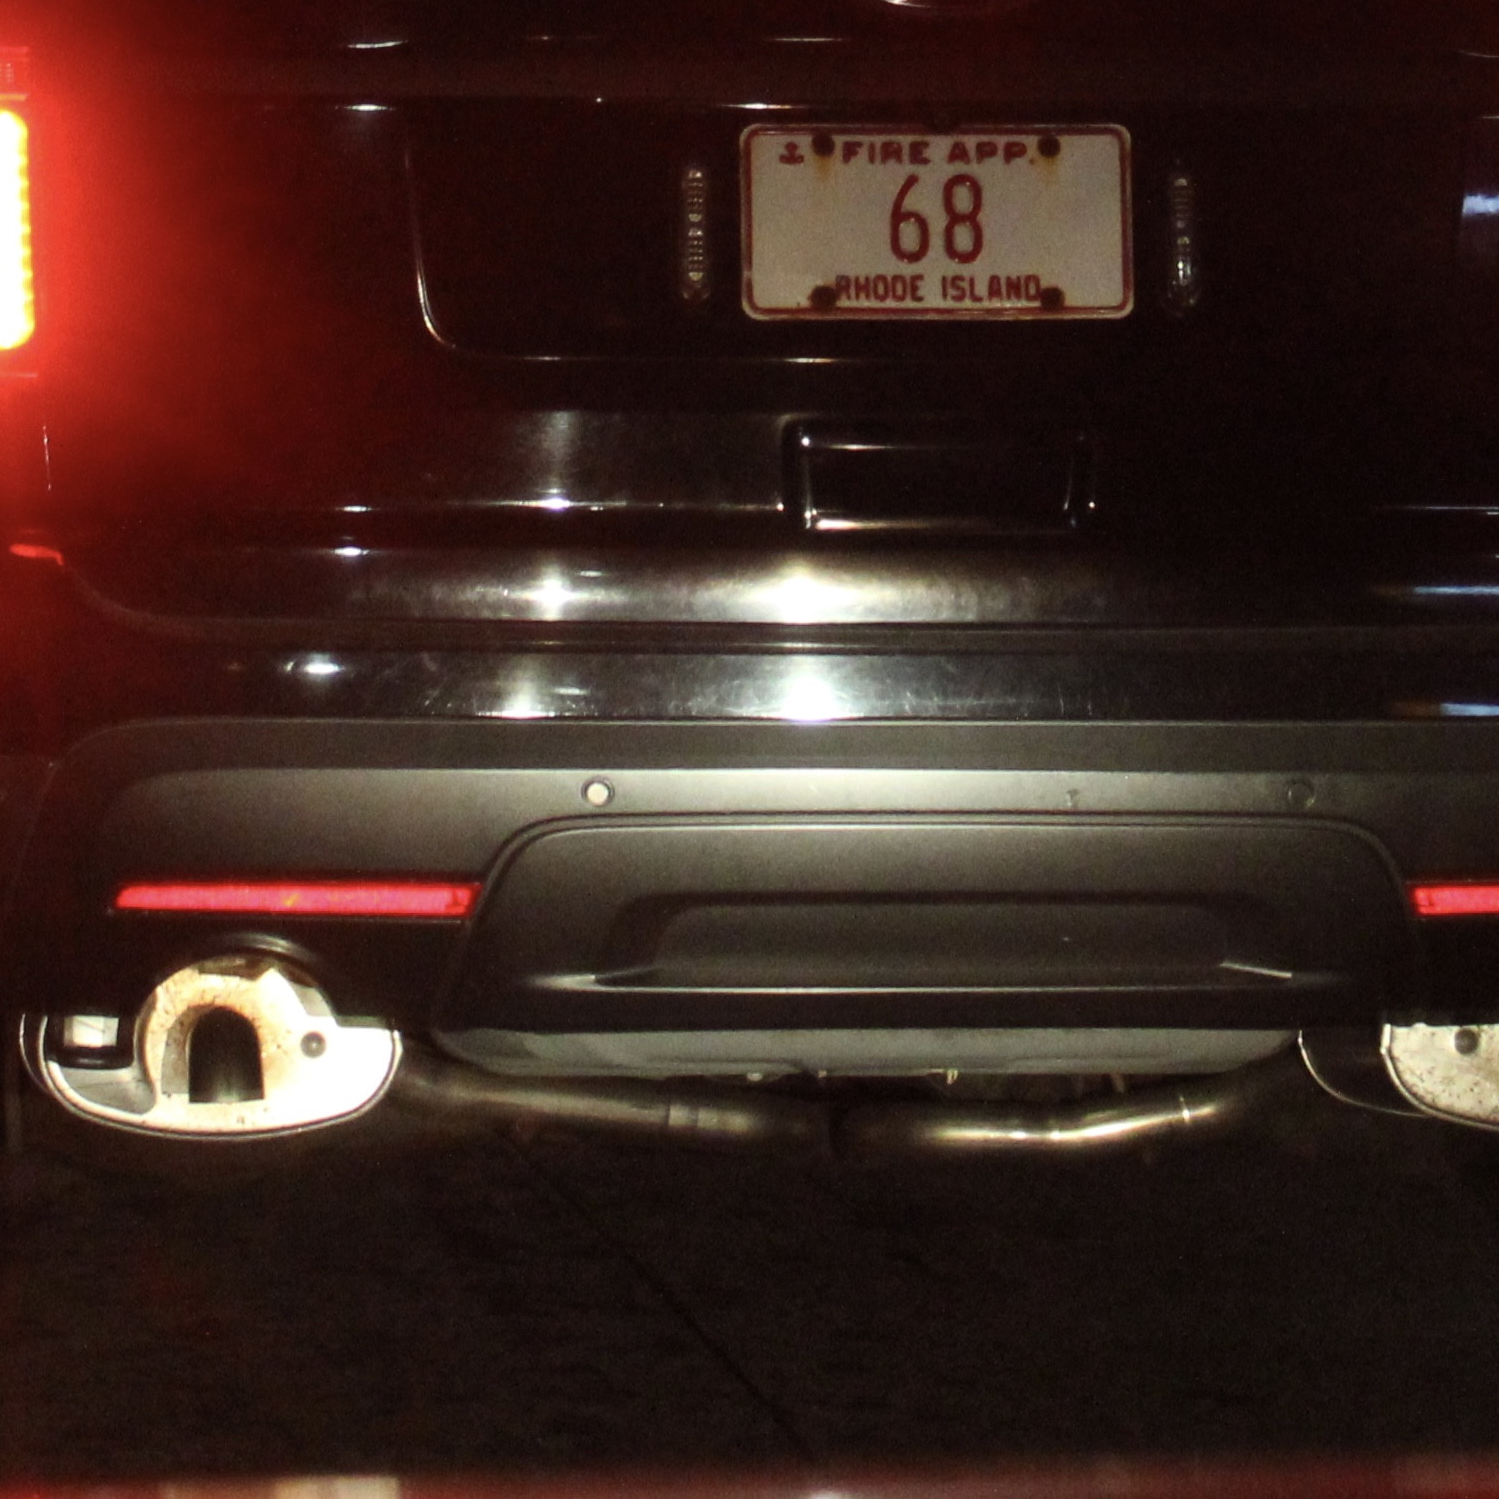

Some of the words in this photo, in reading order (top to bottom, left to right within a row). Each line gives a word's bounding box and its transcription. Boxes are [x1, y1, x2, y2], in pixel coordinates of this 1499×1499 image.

[842, 141, 931, 165] FIRE
[947, 141, 1035, 165] APP.
[890, 174, 983, 264] 68
[835, 275, 924, 302] RHODE
[941, 275, 1042, 302] ISLAND
